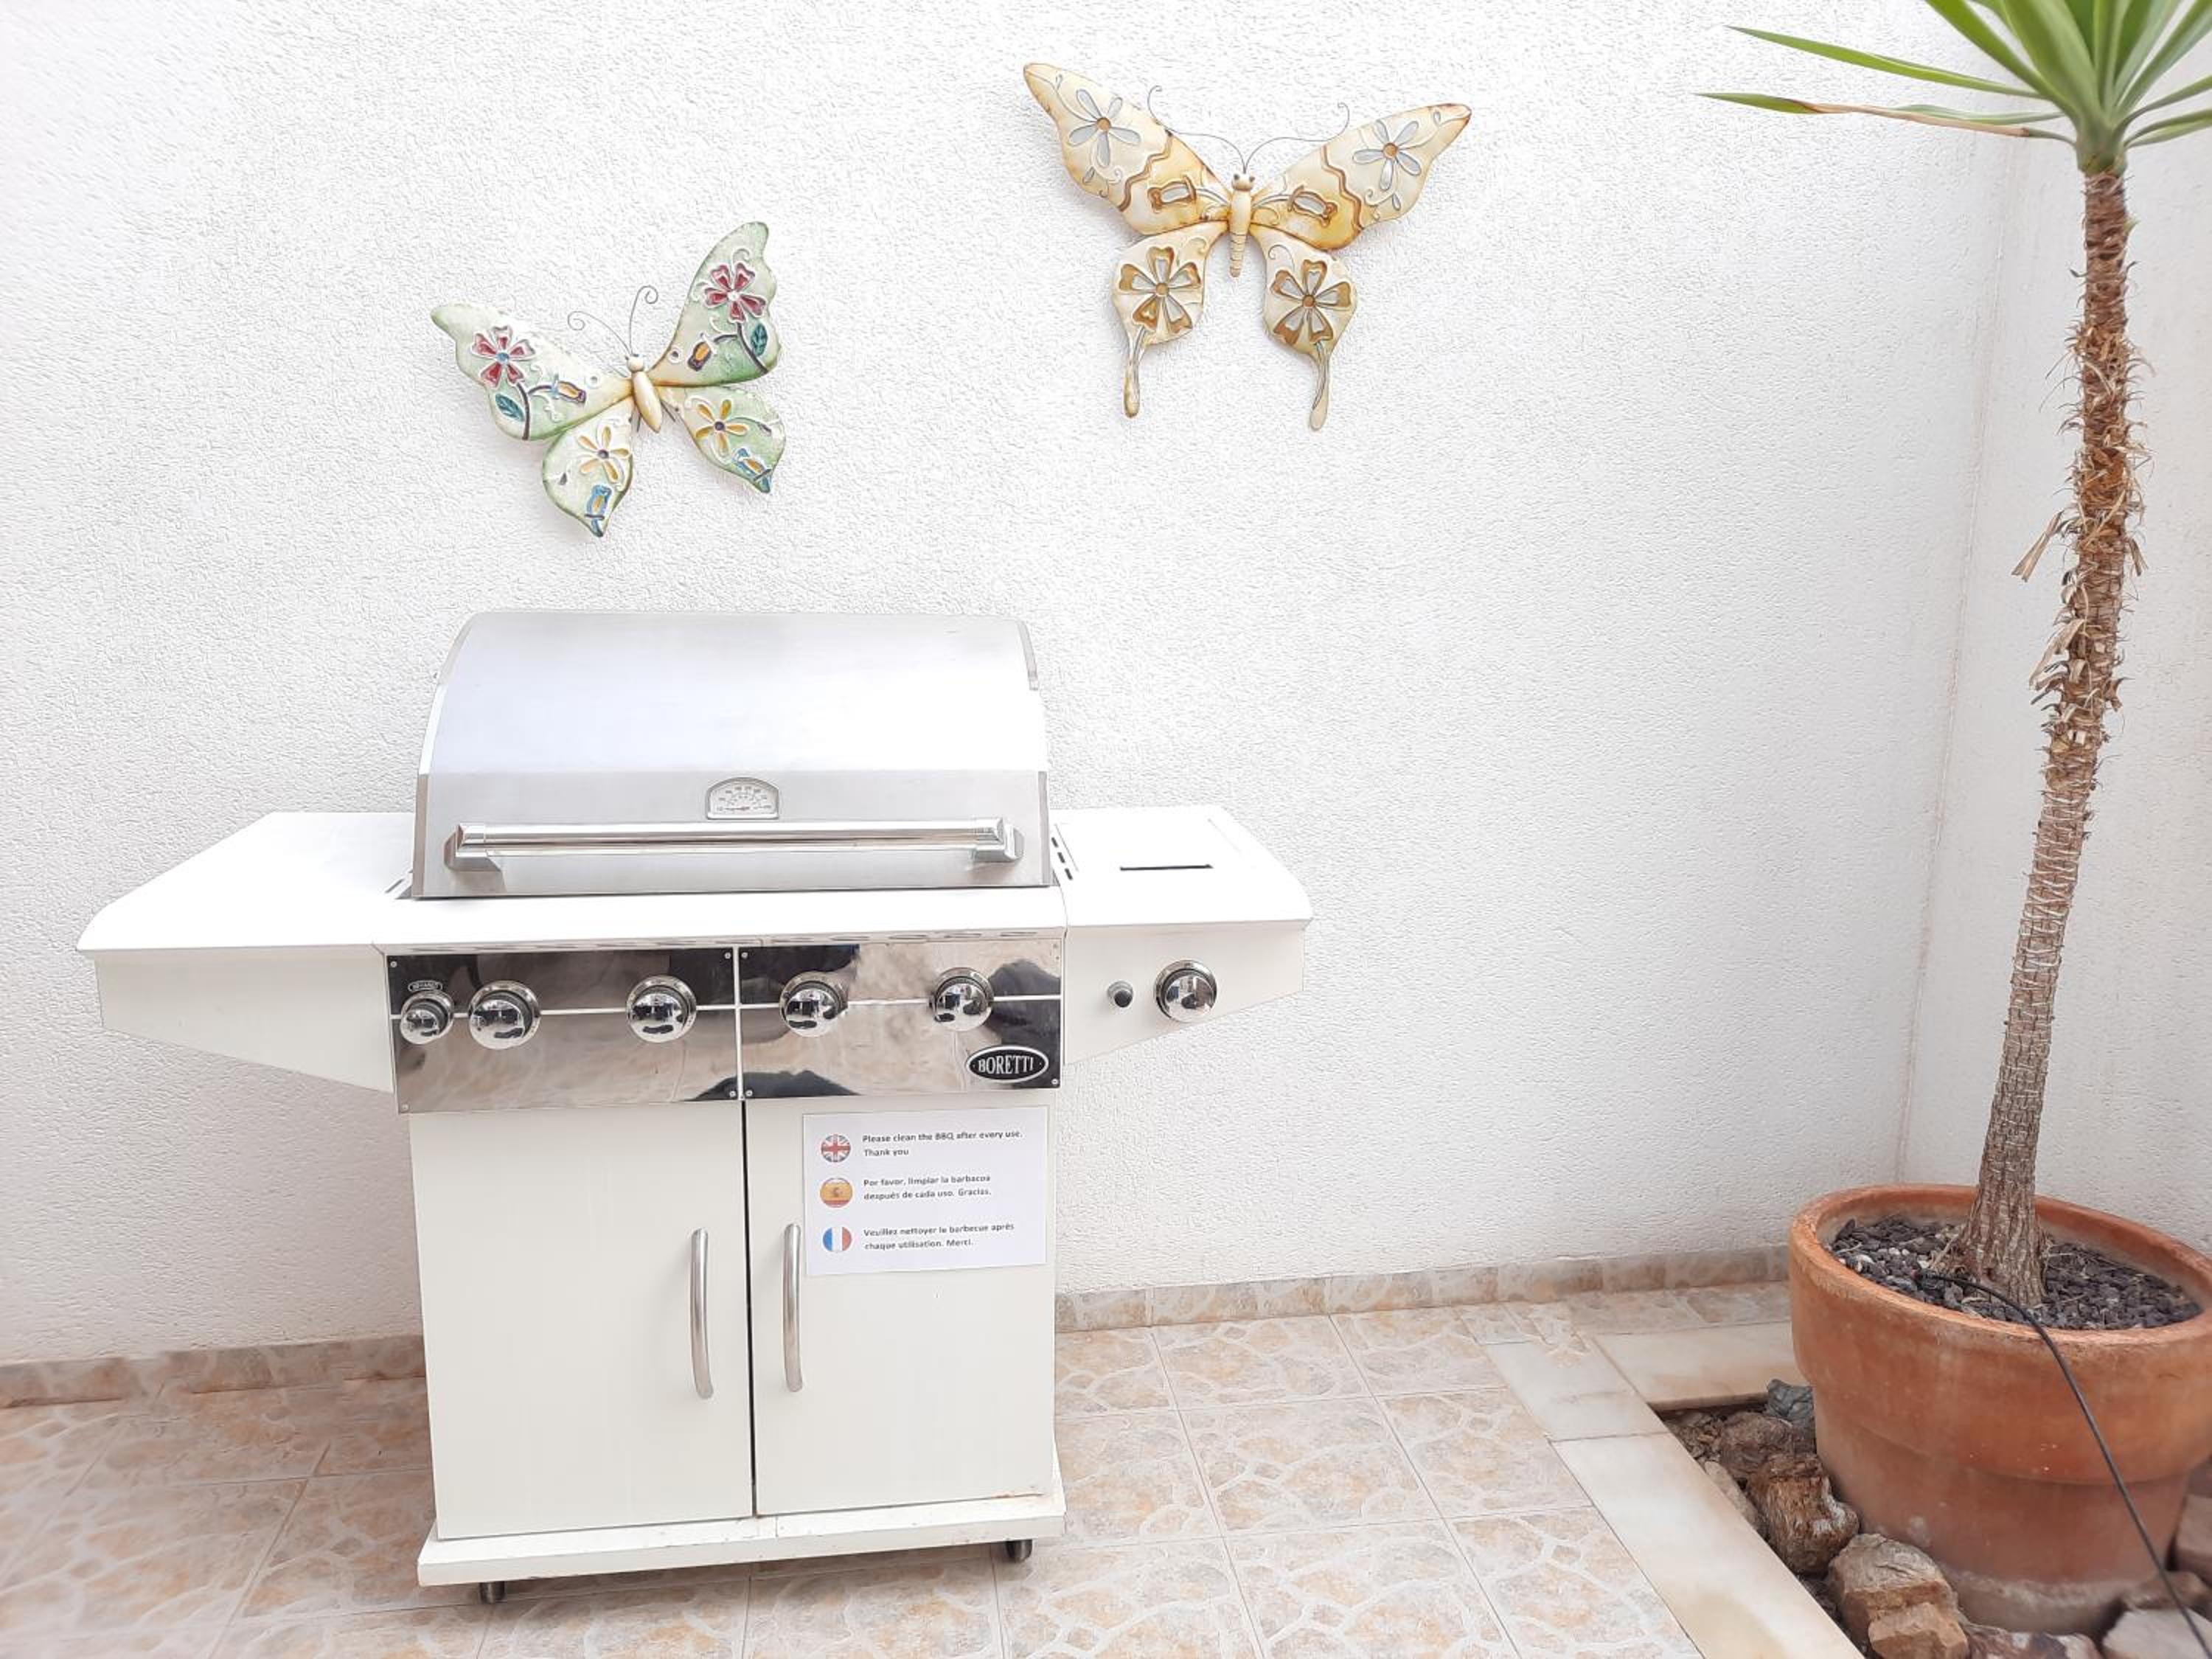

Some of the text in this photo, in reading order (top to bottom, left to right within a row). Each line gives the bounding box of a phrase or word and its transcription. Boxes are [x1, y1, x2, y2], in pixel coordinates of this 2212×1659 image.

[978, 1054, 1034, 1074] BORETTI
[863, 1135, 891, 1143] Please
[893, 1133, 917, 1142] clean
[918, 1133, 933, 1141] the
[935, 1132, 954, 1140] BBQ
[956, 1131, 977, 1139] after
[979, 1131, 1003, 1139] every
[864, 1148, 909, 1157] Thank you
[880, 1178, 906, 1186] favor,
[908, 1176, 939, 1186] limpiar
[950, 1175, 990, 1183] barbacoa
[863, 1192, 900, 1200] después
[915, 1190, 935, 1198] cada
[958, 1188, 992, 1196] Gracias.
[863, 1228, 897, 1237] Veuillez
[949, 1225, 989, 1234] barbecue
[990, 1222, 1015, 1232] après
[865, 1238, 974, 1251] chaque utilisation. Merci.
